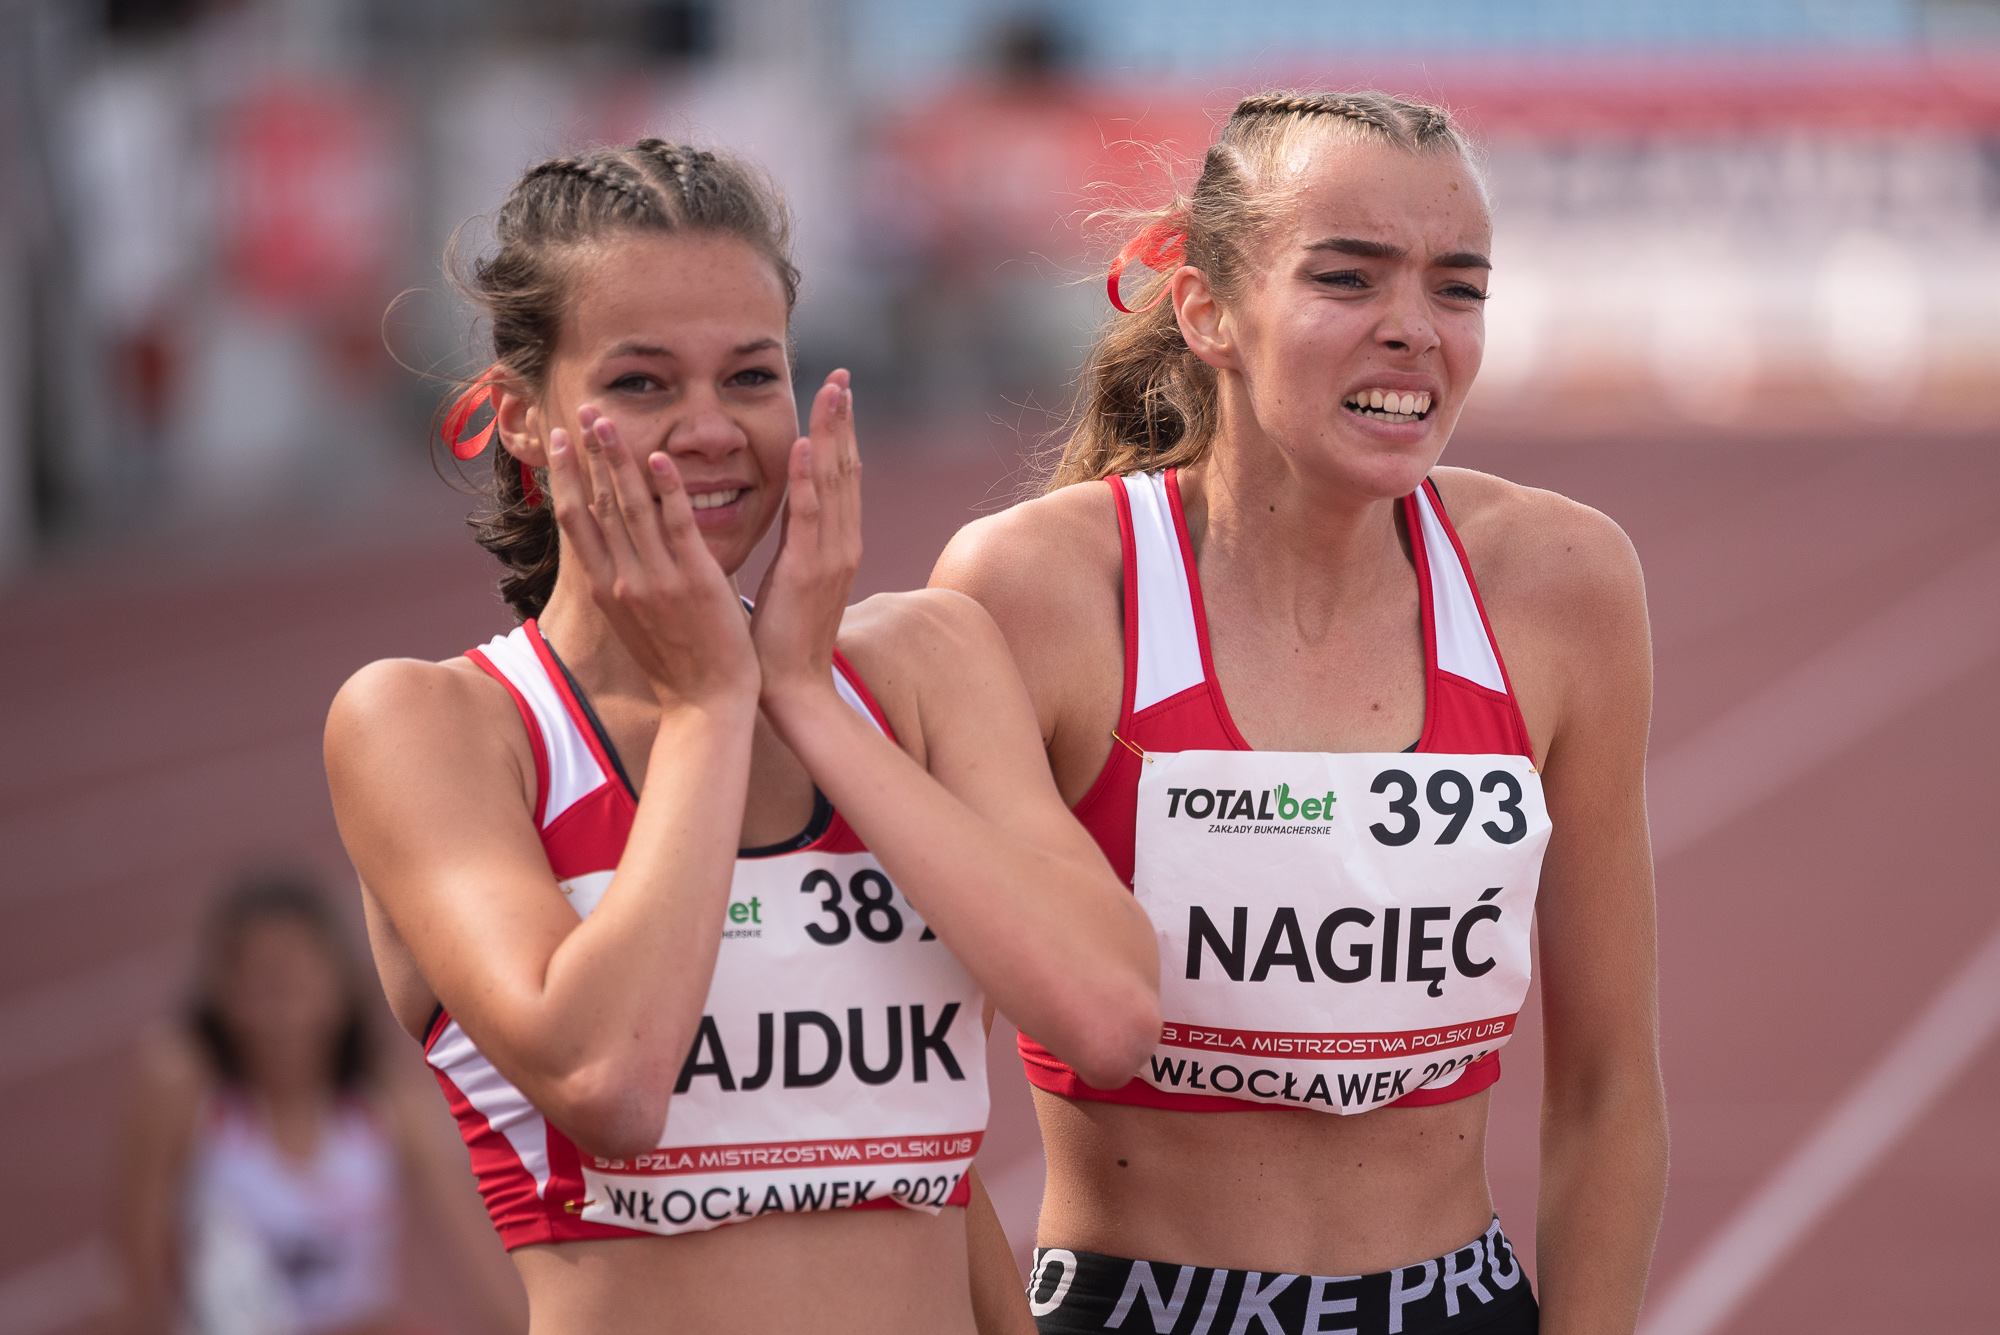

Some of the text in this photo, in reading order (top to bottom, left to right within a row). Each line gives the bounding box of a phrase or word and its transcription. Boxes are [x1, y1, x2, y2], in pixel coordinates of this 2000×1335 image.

[1167, 782, 1337, 821] TOTALbet
[1369, 769, 1528, 847] 393
[1208, 824, 1331, 835] ZAKŁADY BUKMACHERSKIE
[800, 868, 937, 946] 38
[722, 929, 762, 940] HERSKIE
[1185, 887, 1504, 998] NAGIĘĆ
[672, 1002, 966, 1095] AJDUK
[1162, 1021, 1505, 1053] 3. PZLA MISTRZOSTWA POLSKI U18
[1151, 1054, 1413, 1106] WŁOCŁAWEK
[635, 1152, 694, 1171] PZLA
[699, 1143, 862, 1168] MISTRZOSTWA
[865, 1141, 939, 1159] POLSKI
[943, 1137, 972, 1155] U18
[604, 1180, 875, 1225] WŁOCŁAWEK
[1103, 1260, 1362, 1335] NIKE
[1389, 1218, 1520, 1334] PRO
